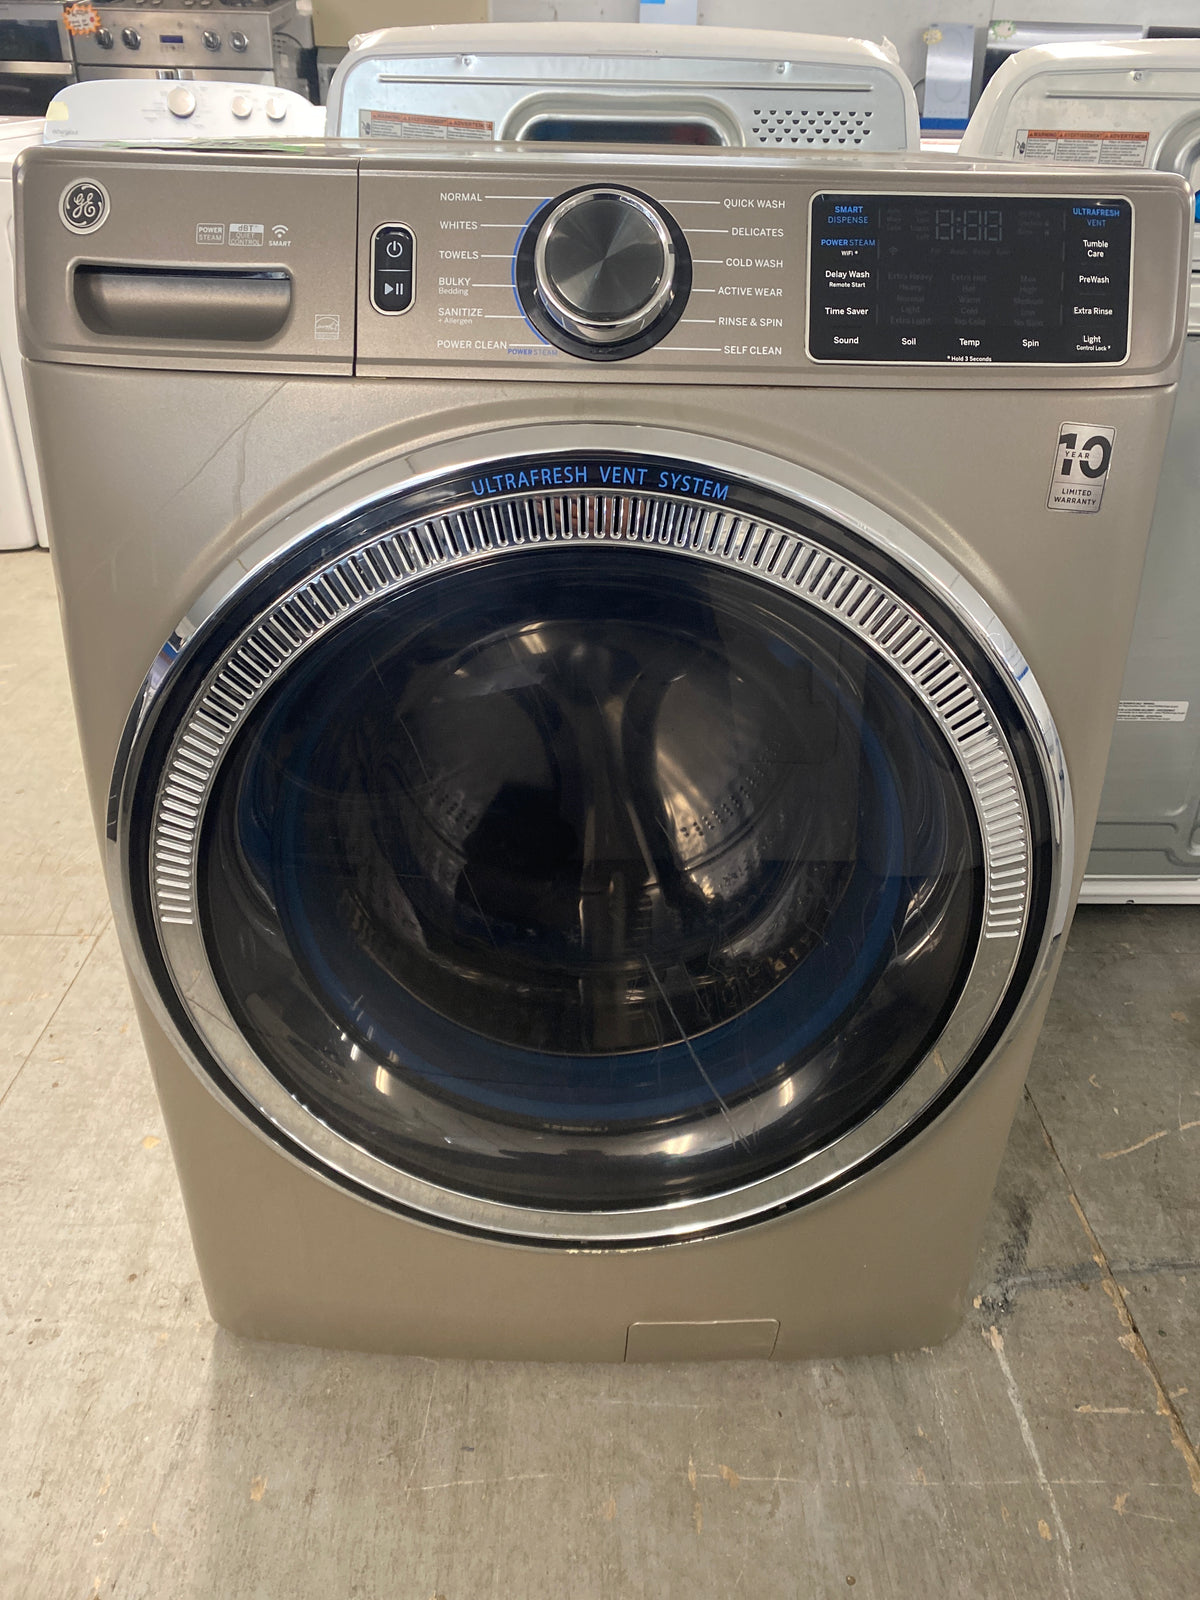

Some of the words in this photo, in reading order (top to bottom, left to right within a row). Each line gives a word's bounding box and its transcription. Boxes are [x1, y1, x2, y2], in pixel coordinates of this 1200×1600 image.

[440, 192, 482, 201] NORMAL
[724, 199, 754, 208] QUICK
[757, 200, 785, 208] WASH
[1072, 208, 1120, 216] ULTRAFRESH
[828, 216, 868, 224] DISPENSE
[1087, 219, 1106, 227] VENT
[440, 221, 478, 230] WHITES
[732, 227, 784, 237] DELICATES
[1083, 240, 1109, 248] Tumble
[439, 251, 479, 259] TOWELS
[1088, 250, 1104, 258] Care
[726, 258, 752, 267] COLD
[755, 259, 783, 268] WASH
[825, 270, 847, 279] Delay
[1079, 275, 1110, 283] PreWash
[439, 277, 471, 286] BULKY
[439, 287, 468, 296] Bedding
[718, 287, 752, 296] ACTIVE
[754, 288, 782, 296] WEAR
[438, 308, 483, 317] SANITIZE
[1094, 307, 1112, 315] Rinse
[718, 317, 747, 326] RINSE
[750, 318, 757, 326] &
[760, 318, 783, 327] SPIN
[834, 336, 859, 344] Sound
[959, 338, 980, 347] Temp
[1022, 339, 1039, 348] Spin
[1083, 335, 1101, 344] Light
[437, 340, 472, 349] POWER
[474, 340, 507, 349] CLEAN
[724, 346, 748, 354] SELF
[750, 346, 782, 355] CLEAN
[1059, 433, 1112, 478] 10
[1065, 450, 1090, 459] YEAR
[471, 466, 588, 496] ULTRAFRESH
[600, 466, 648, 486] VENT
[658, 471, 729, 501] SYSTEM
[1062, 488, 1092, 496] LIMITED
[1054, 496, 1096, 505] WARRANTY
